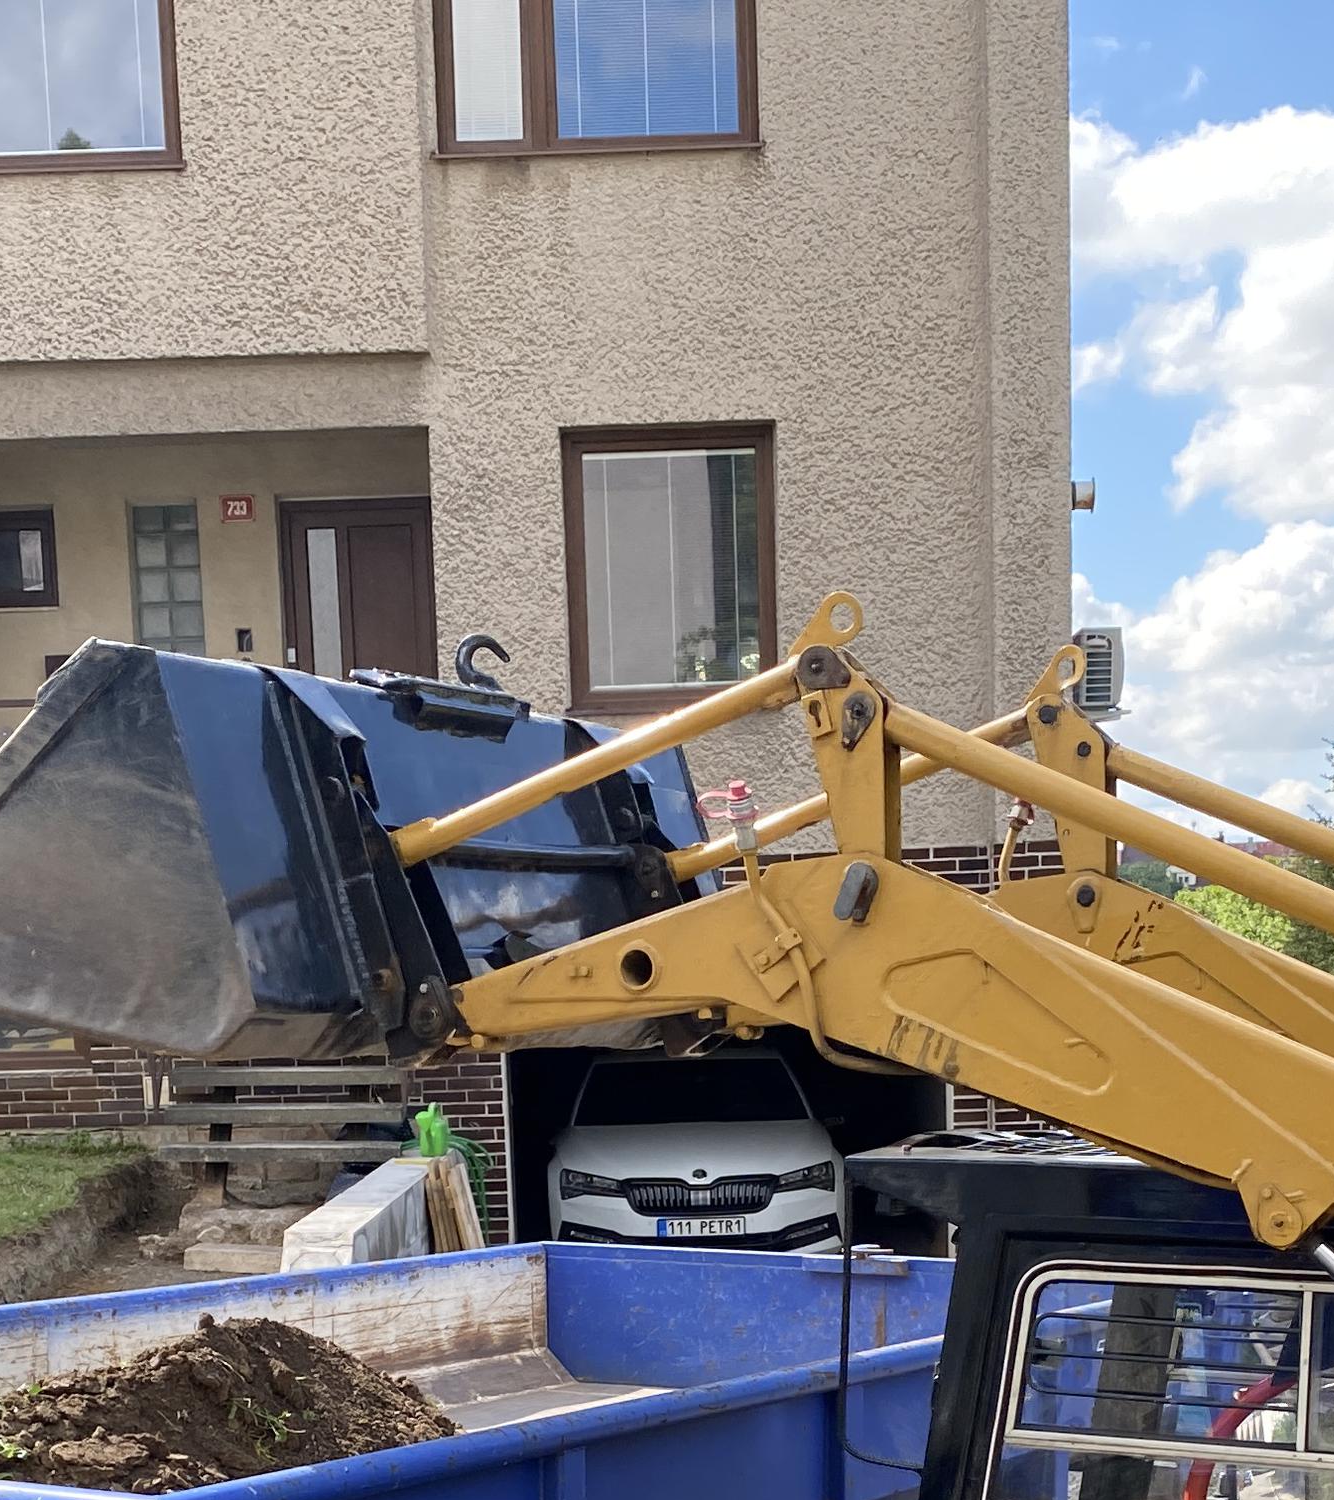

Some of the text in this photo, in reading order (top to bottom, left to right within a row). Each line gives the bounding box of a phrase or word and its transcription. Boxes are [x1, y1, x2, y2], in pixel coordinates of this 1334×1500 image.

[227, 500, 247, 516] 733
[668, 1221, 692, 1235] 111
[700, 1219, 741, 1234] PETR1
